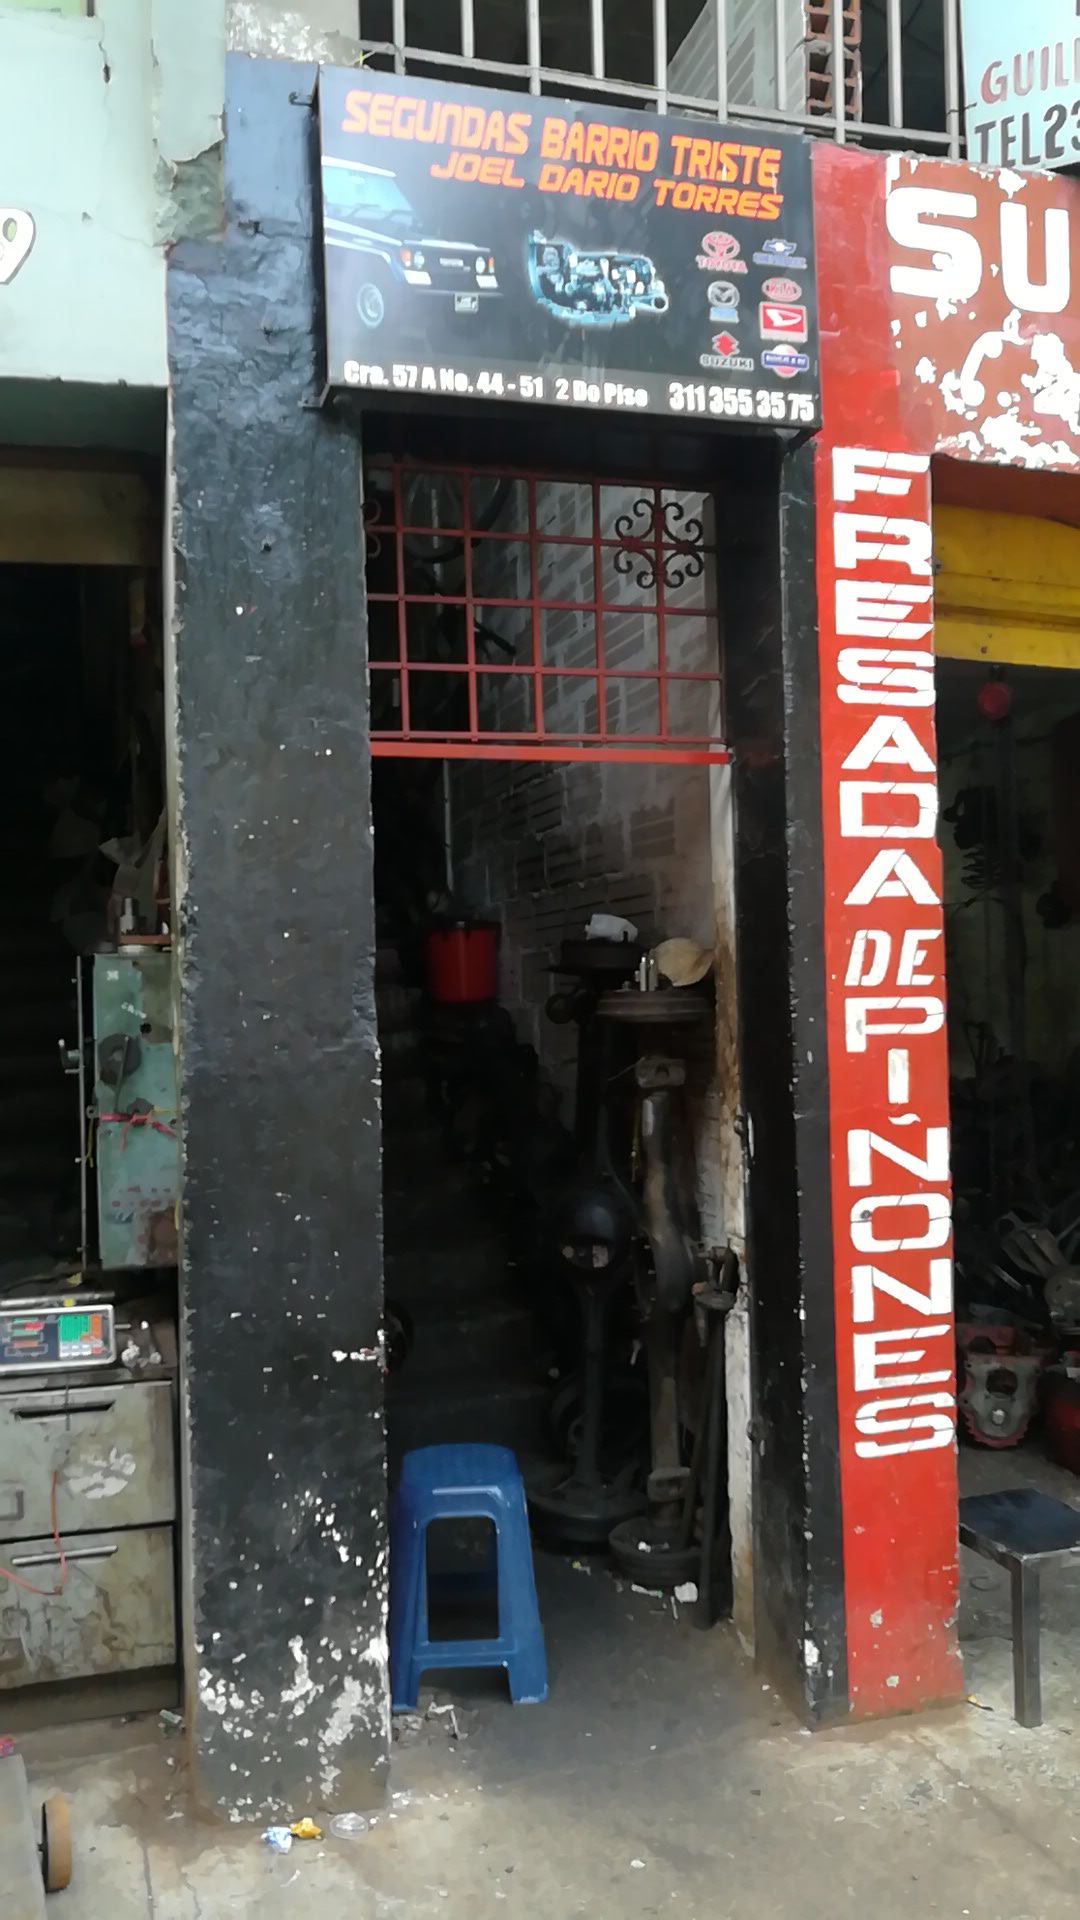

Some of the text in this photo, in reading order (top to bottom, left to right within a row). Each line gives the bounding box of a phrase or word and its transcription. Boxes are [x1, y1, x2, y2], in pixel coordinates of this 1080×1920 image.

[981, 37, 1080, 104] GUIL
[341, 90, 782, 188] SEGUNDAS BARRIO TRISTE
[430, 151, 784, 220] JOEL DARIO TORRES
[885, 186, 1070, 313] SU
[344, 360, 389, 386] Cra.
[554, 378, 570, 401] 2
[572, 379, 601, 403] Do
[603, 382, 649, 407] Piso
[669, 382, 815, 422] 311 355 35 75
[832, 446, 956, 1460] FRESADA DE PIÑONES
